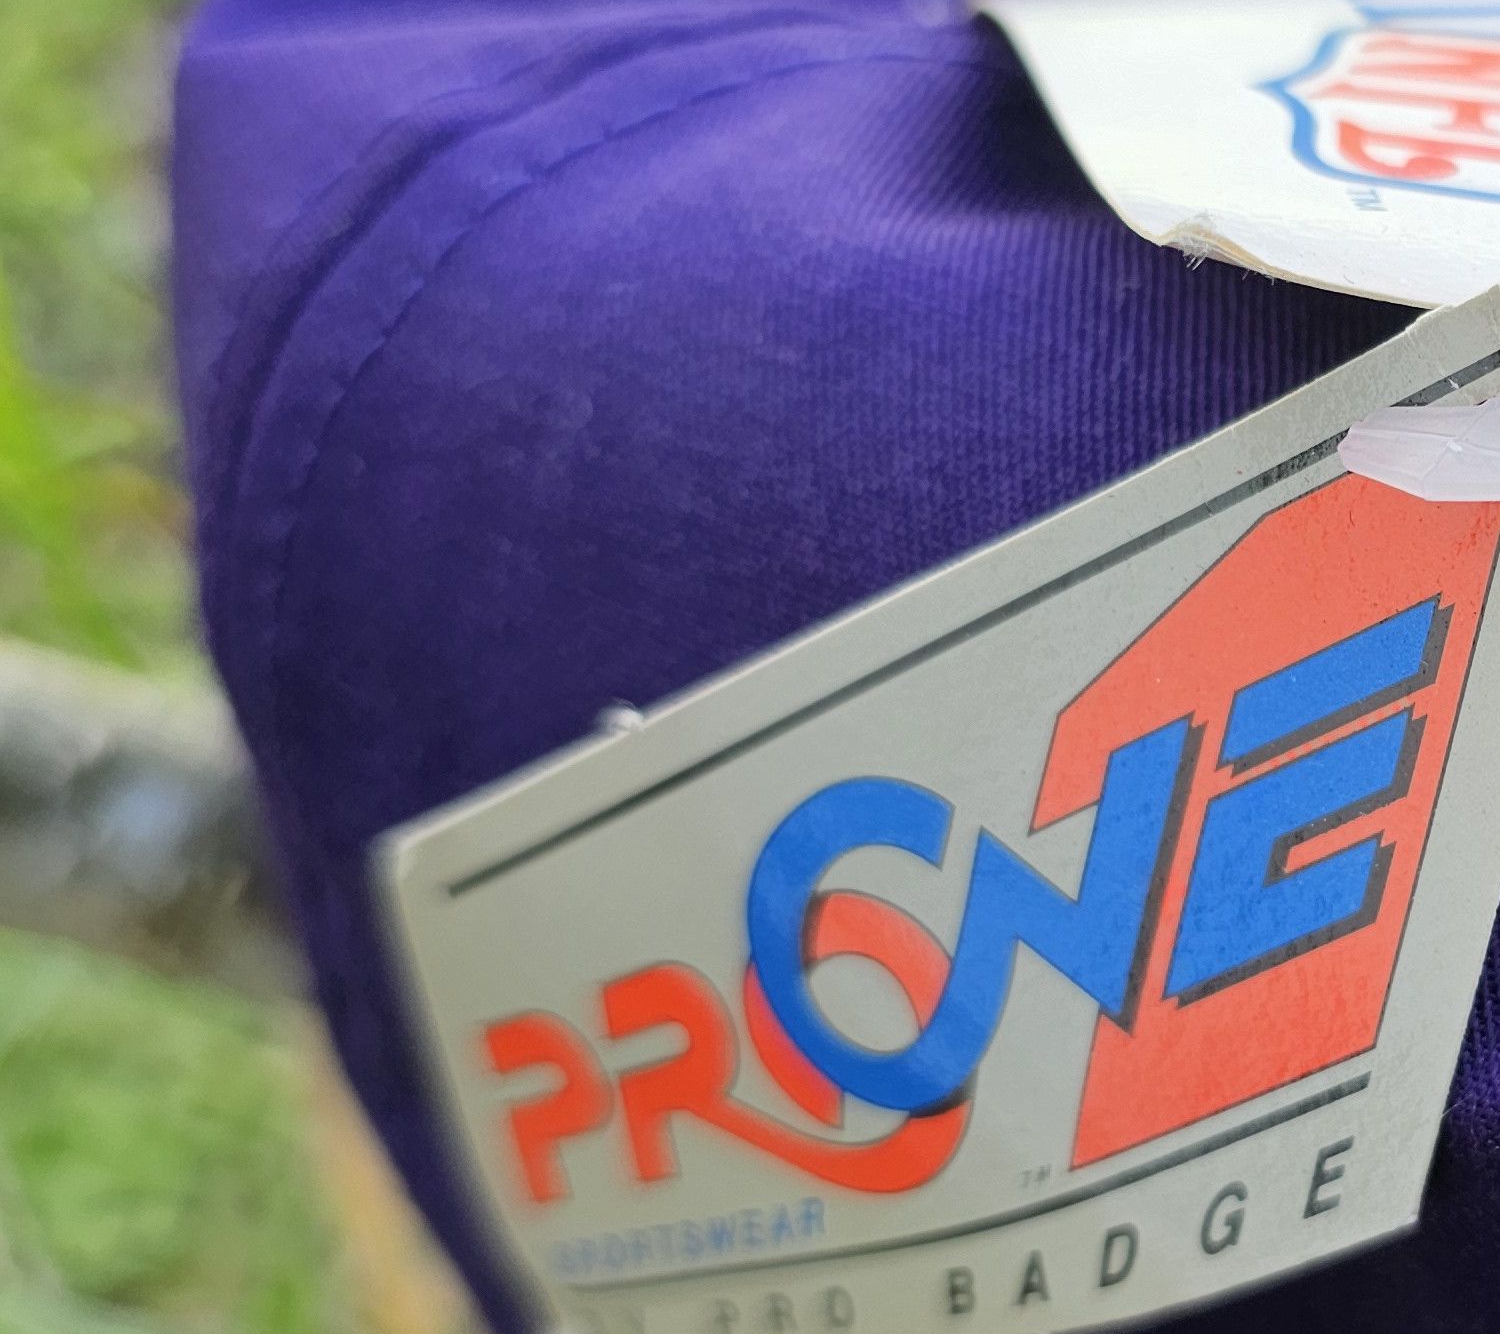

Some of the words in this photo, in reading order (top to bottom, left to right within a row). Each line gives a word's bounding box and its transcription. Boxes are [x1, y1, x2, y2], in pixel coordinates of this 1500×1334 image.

[476, 887, 976, 1207] PRO
[745, 590, 1456, 1115] ONE
[945, 1134, 1356, 1316] BADGE
